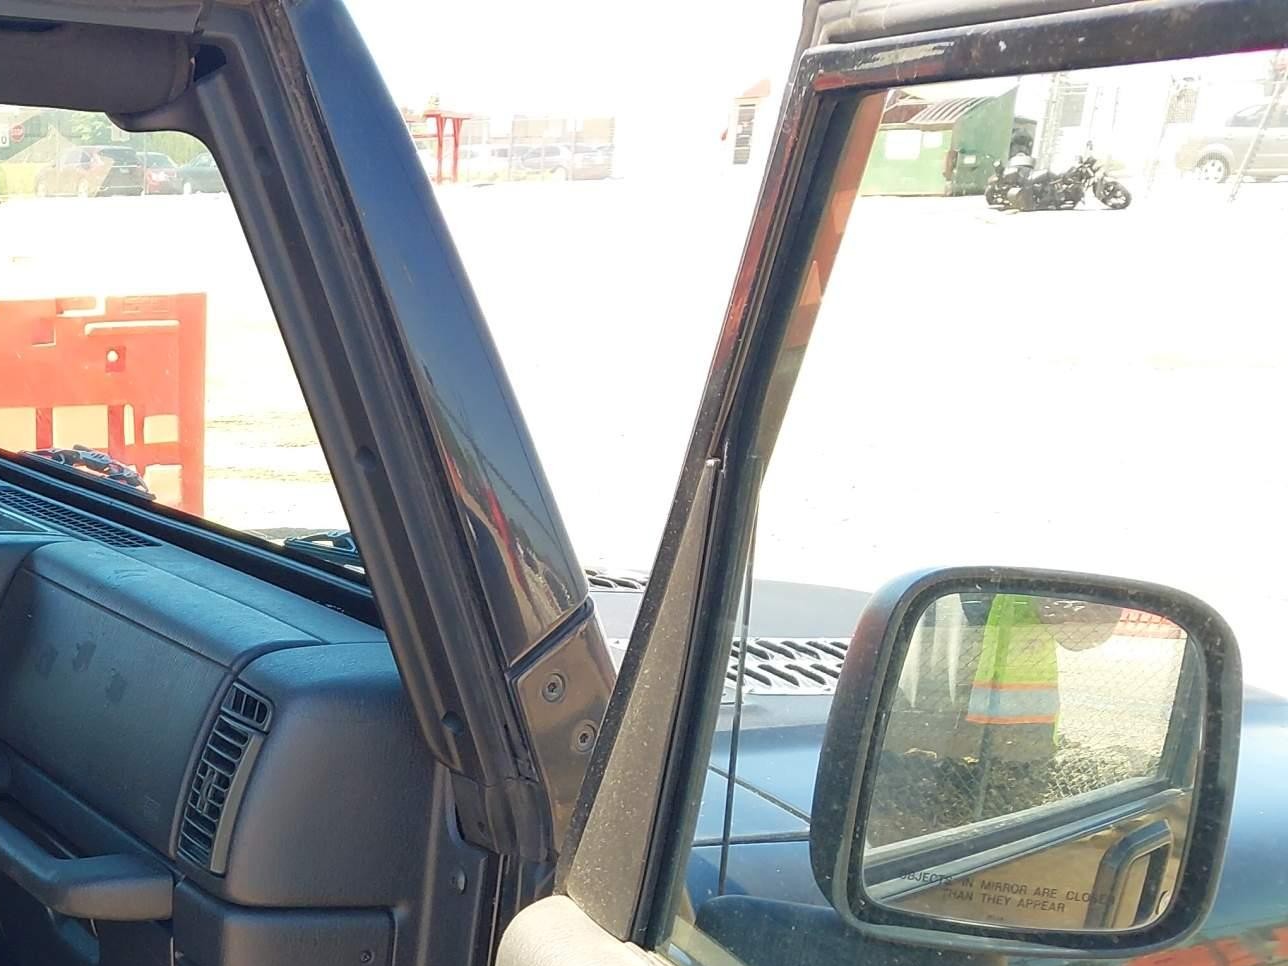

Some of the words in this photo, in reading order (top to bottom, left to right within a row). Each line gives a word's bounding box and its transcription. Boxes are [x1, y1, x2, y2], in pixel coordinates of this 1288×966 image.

[943, 887, 974, 901] THAN
[980, 893, 1012, 907] THEY
[1016, 898, 1066, 914] APPEAR
[980, 879, 1028, 896] MIRROR
[1033, 886, 1057, 900] ARE
